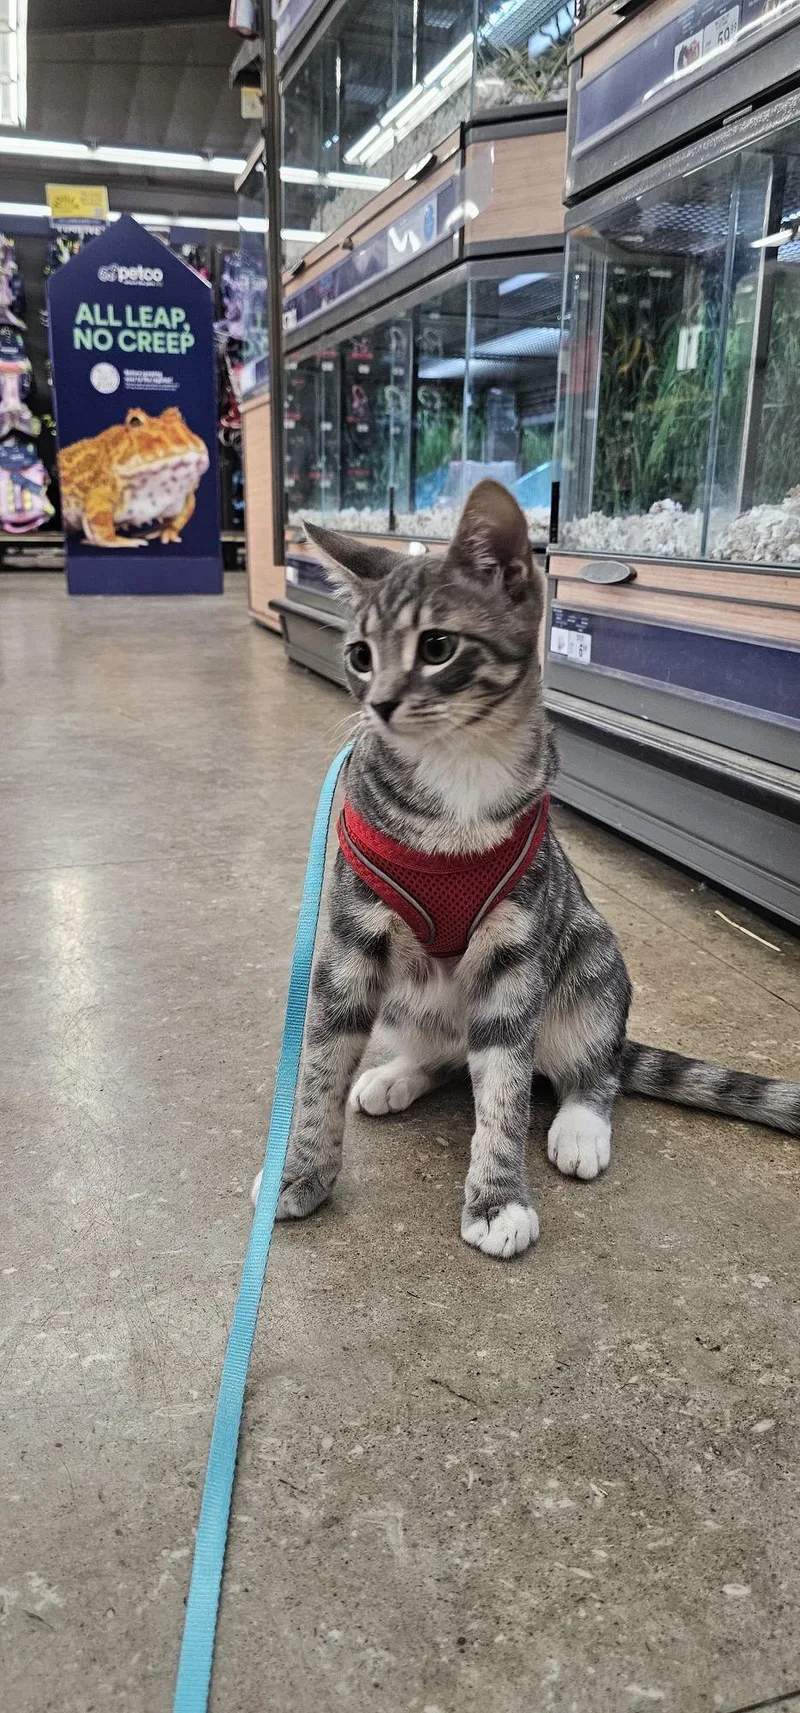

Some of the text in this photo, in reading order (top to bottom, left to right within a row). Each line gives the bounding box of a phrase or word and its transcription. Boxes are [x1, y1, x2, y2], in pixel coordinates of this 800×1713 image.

[117, 265, 164, 283] petco
[75, 302, 191, 334] ALL LEAP,
[73, 328, 195, 355] NO CREEP
